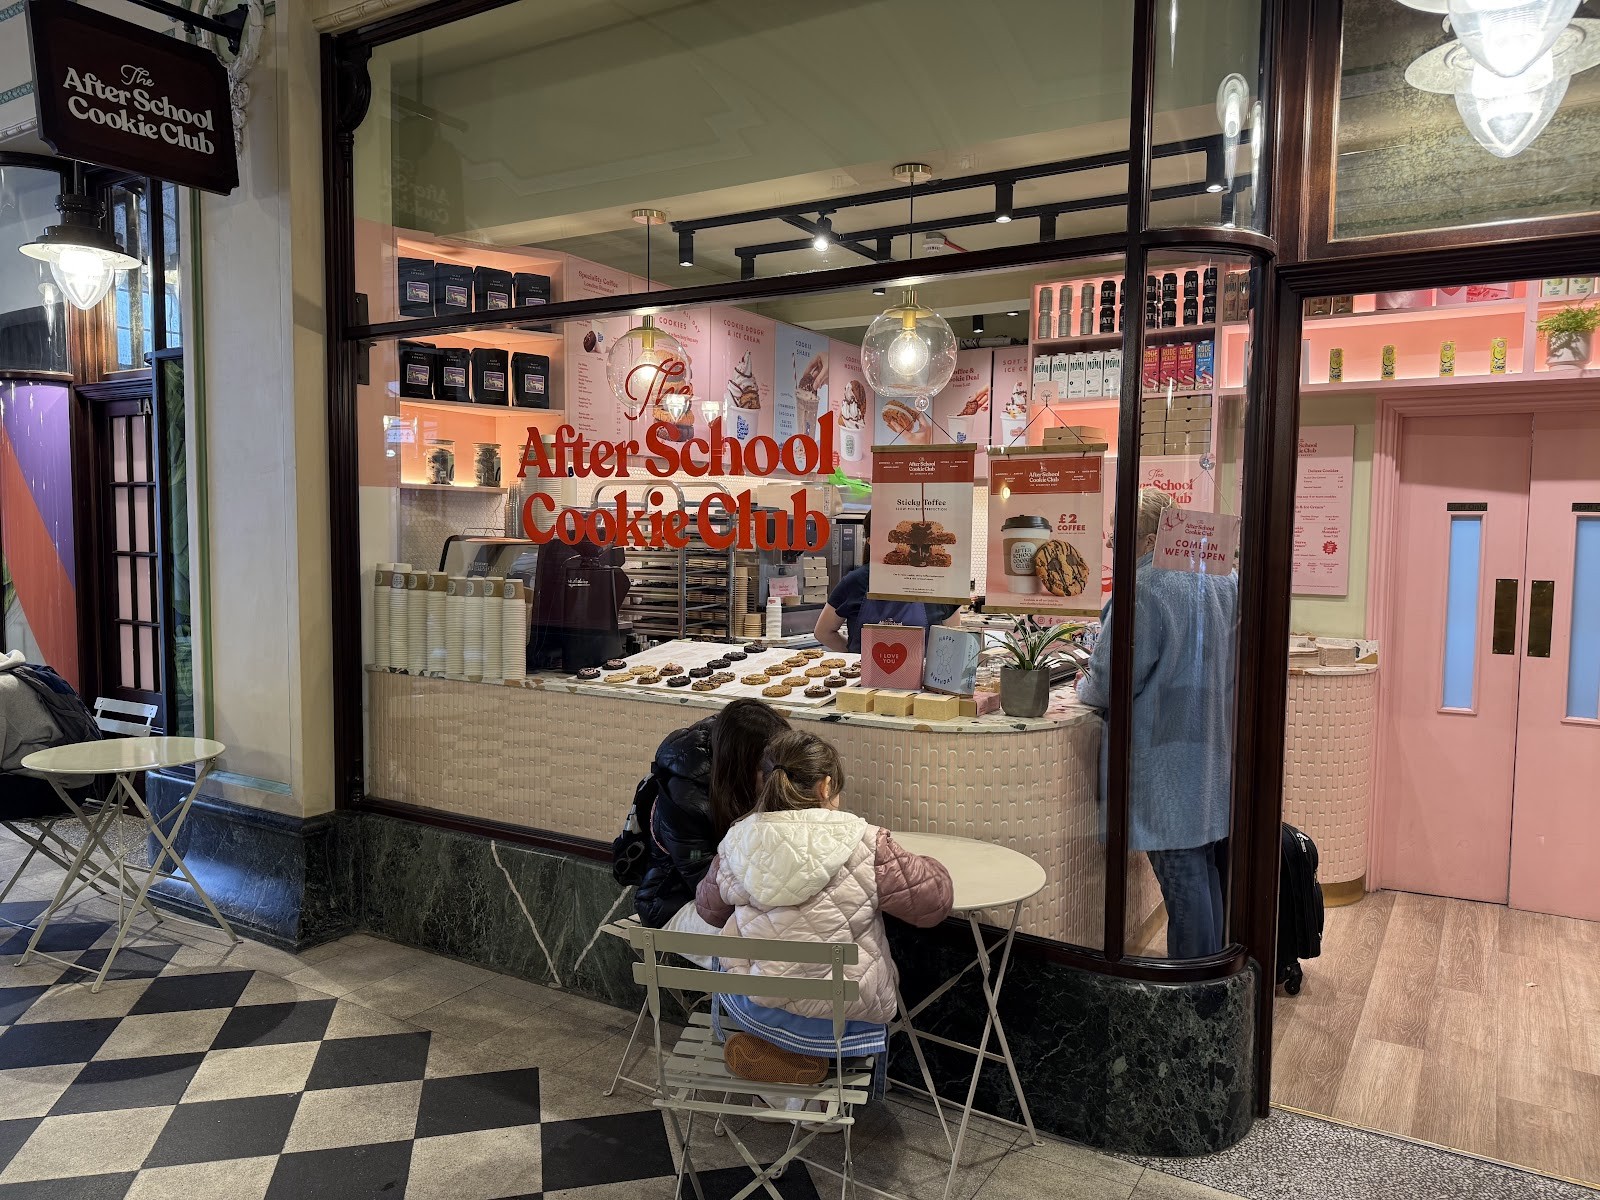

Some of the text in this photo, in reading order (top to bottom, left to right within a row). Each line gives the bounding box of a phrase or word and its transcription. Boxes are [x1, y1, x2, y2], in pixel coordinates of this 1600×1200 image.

[120, 64, 155, 88] The
[62, 67, 215, 132] After School
[67, 96, 215, 155] Cookie Club
[658, 317, 687, 330] COOKIES
[723, 319, 765, 336] COOKIE DOUGH
[733, 331, 742, 340] ICE
[743, 334, 761, 345] CREAM
[624, 357, 694, 421] The
[136, 398, 152, 416] 1A
[517, 424, 639, 478] After
[645, 411, 836, 478] School
[1147, 468, 1164, 481] The
[1153, 478, 1193, 491] School
[896, 498, 947, 507] Sticky Toffee
[522, 489, 830, 551] Cookie Club
[1058, 513, 1078, 524] £2
[1185, 523, 1215, 532] After School
[1185, 528, 1202, 536] Cookie
[1175, 539, 1218, 551] COME IN
[1165, 547, 1226, 562] WE'RE OPEN
[938, 635, 955, 643] HAPPY
[930, 672, 953, 685] BIRTHDAY
